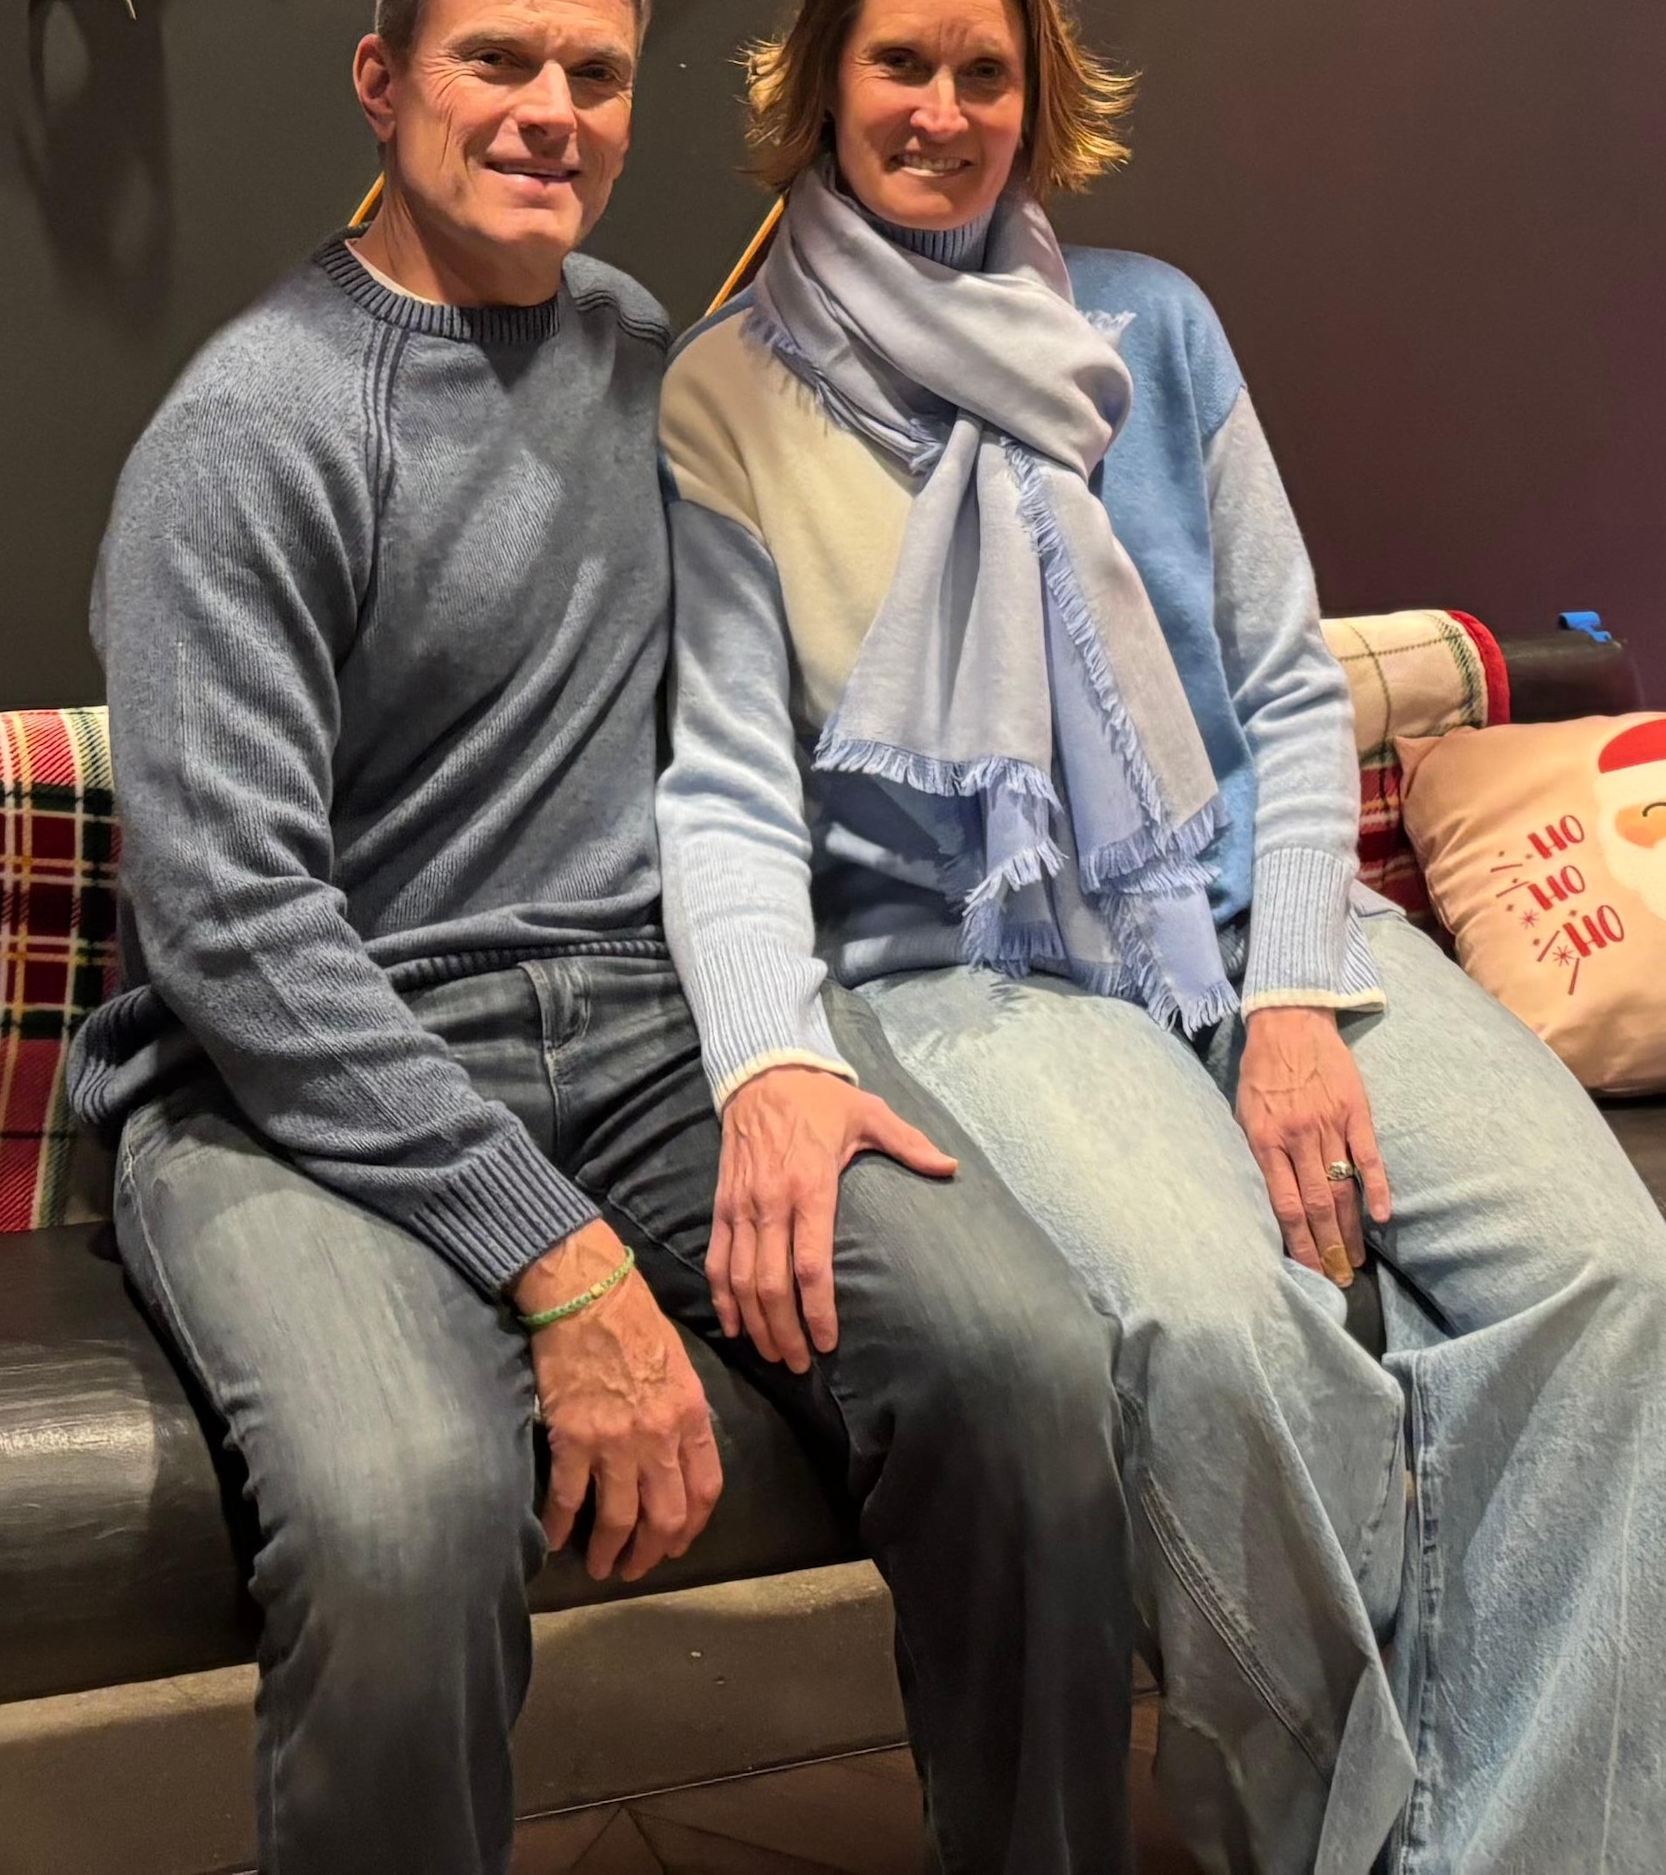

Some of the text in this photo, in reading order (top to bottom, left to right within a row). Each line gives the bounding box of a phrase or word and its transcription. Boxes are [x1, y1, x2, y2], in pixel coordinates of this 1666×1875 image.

[1527, 814, 1585, 860] HO
[1527, 865, 1586, 911] HO
[1562, 904, 1624, 958] HO
